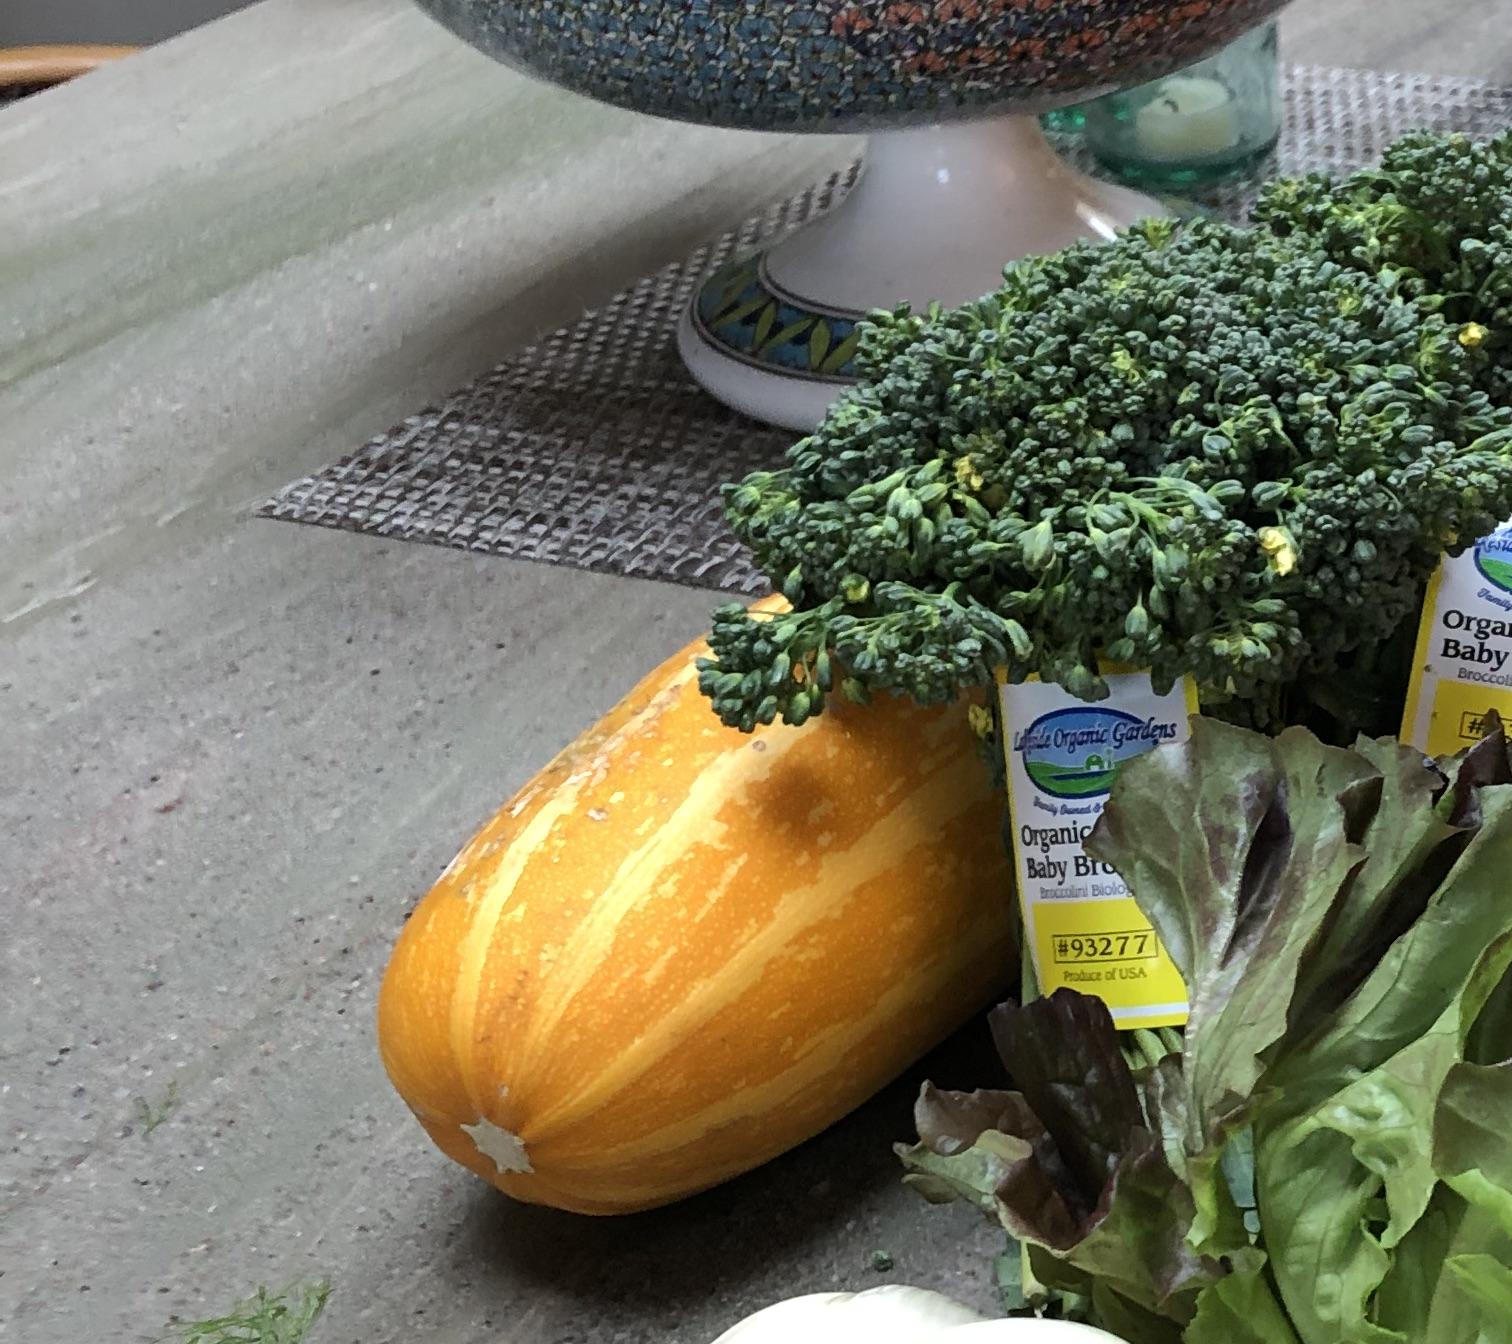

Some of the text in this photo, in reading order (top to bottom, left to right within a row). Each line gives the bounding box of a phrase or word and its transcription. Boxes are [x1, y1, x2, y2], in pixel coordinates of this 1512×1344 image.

[1440, 638, 1510, 672] Baby
[1053, 722, 1109, 753] Organic
[1112, 717, 1177, 750] Gardens
[1026, 855, 1067, 886] Baby
[1057, 934, 1149, 958] #93277
[1063, 967, 1147, 982] Produce of USA
